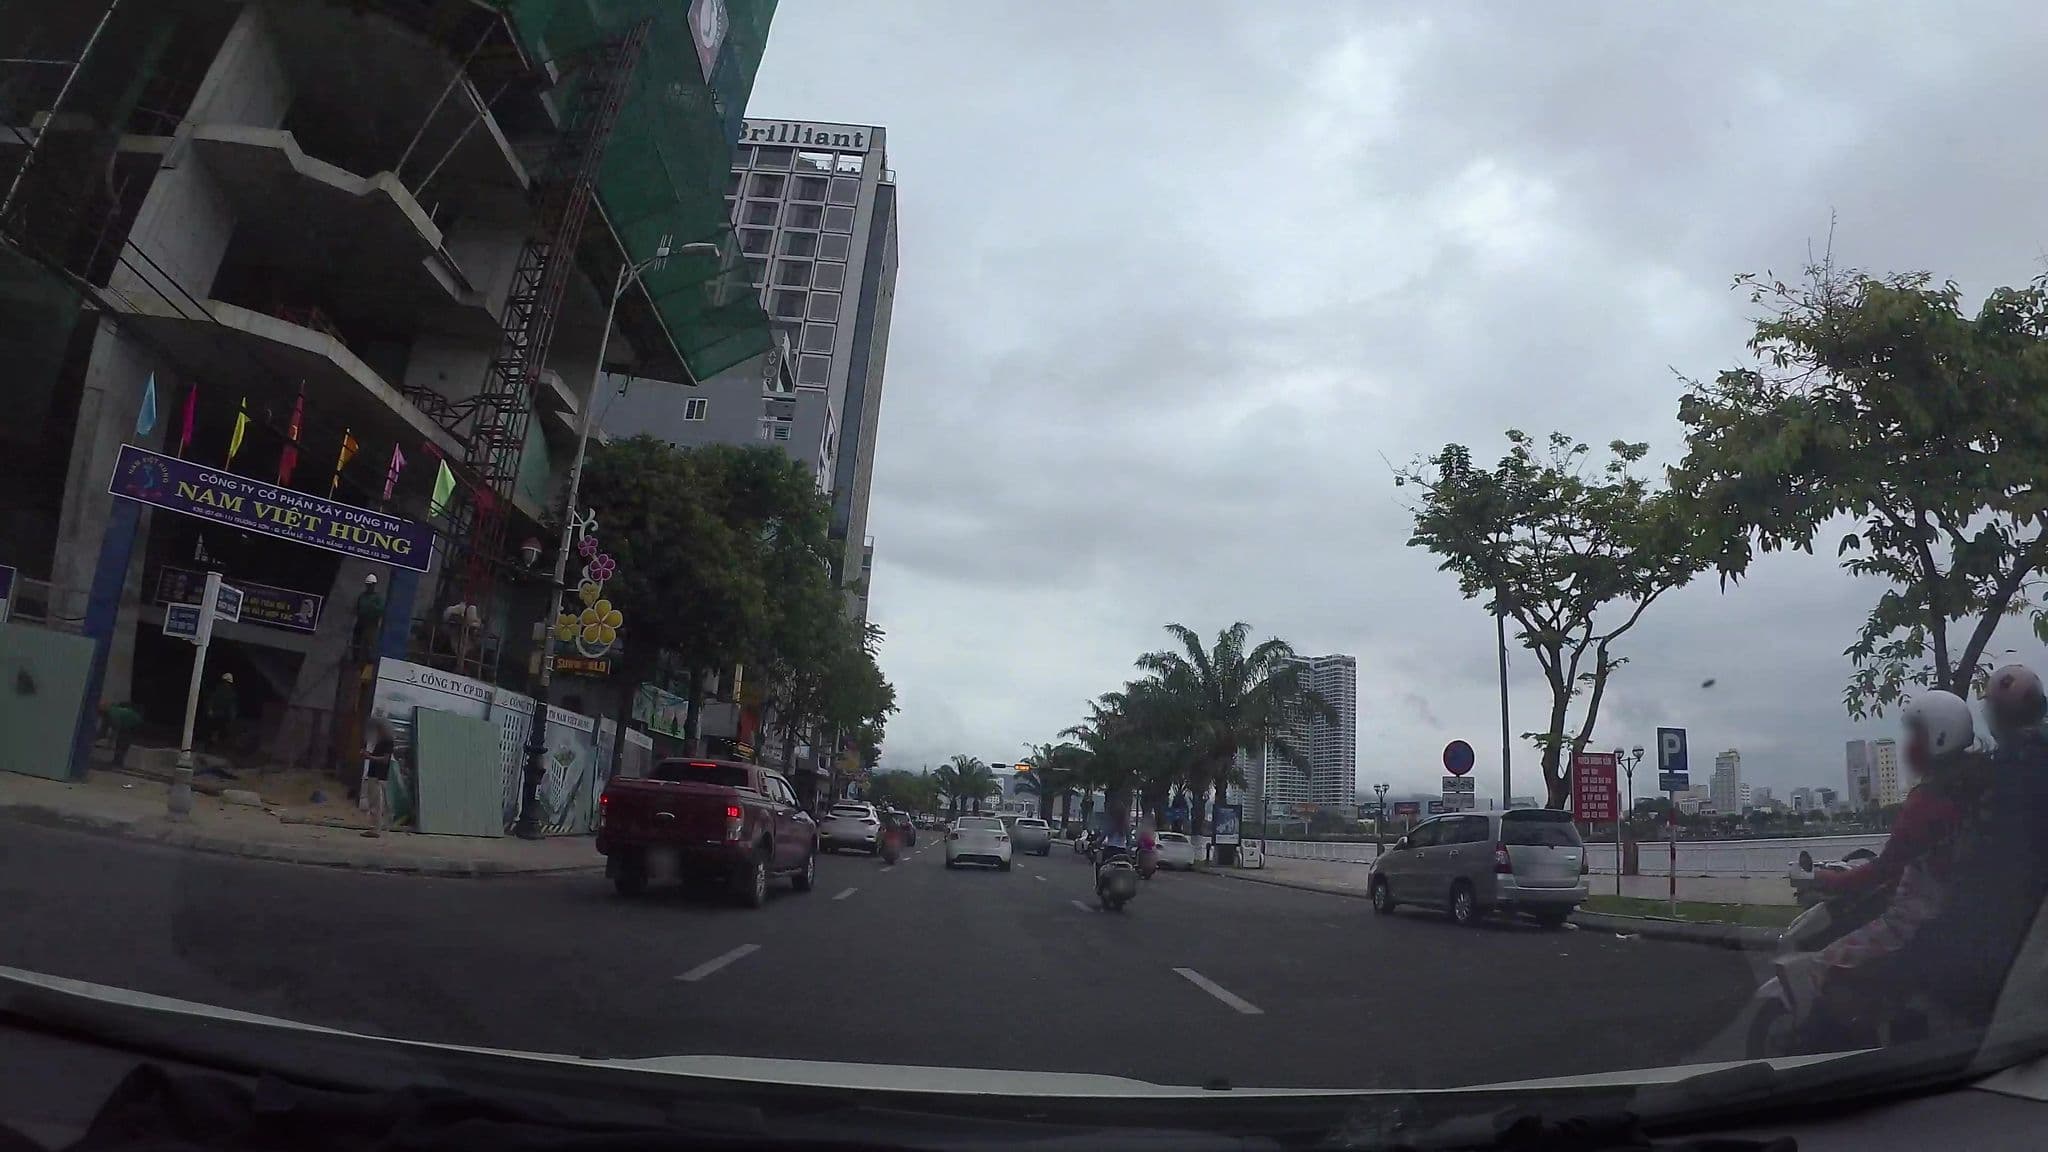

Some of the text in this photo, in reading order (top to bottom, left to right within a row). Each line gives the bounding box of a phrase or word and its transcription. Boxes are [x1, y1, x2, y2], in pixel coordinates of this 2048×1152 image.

[740, 121, 863, 147] Brilliant
[174, 481, 246, 512] NAM
[253, 501, 322, 532] VIỆT
[328, 521, 412, 555] HÙNG
[199, 473, 238, 489] CÔNG
[241, 483, 255, 494] TY
[316, 504, 342, 517] XÂY
[345, 511, 381, 527] DỰNG
[384, 521, 400, 532] TM
[421, 673, 448, 689] CÔNG
[450, 681, 462, 692] TY
[1662, 732, 1681, 767] P
